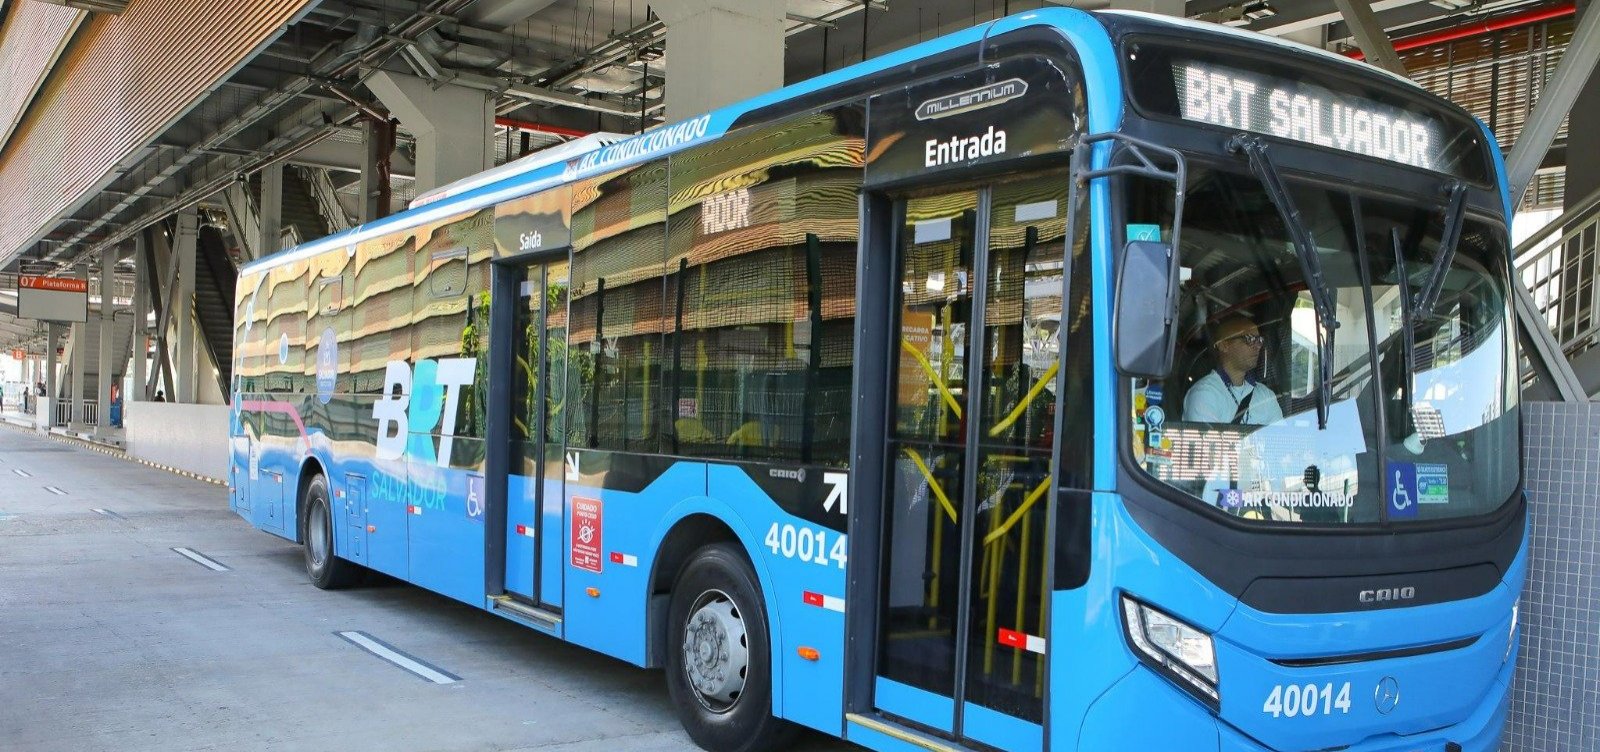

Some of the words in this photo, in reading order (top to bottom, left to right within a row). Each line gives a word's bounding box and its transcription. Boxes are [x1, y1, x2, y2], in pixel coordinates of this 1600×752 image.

[927, 84, 1015, 114] MILLENNIUM
[1186, 66, 1255, 130] BRT
[1269, 89, 1429, 170] SALVADOR
[578, 150, 599, 172] AR
[600, 114, 711, 167] CONDICIONADO
[925, 126, 1006, 167] Entrada
[519, 230, 542, 250] Saída
[21, 276, 37, 287] 07
[42, 280, 80, 289] Plataforma
[372, 358, 477, 468] BRT
[371, 471, 447, 510] SALVADOR
[769, 468, 797, 479] CAIO
[1243, 491, 1263, 507] AR
[1265, 491, 1354, 508] CONDICIONADO
[765, 522, 848, 570] 40014
[1360, 586, 1416, 603] CAIO
[1262, 681, 1351, 718] 40014
